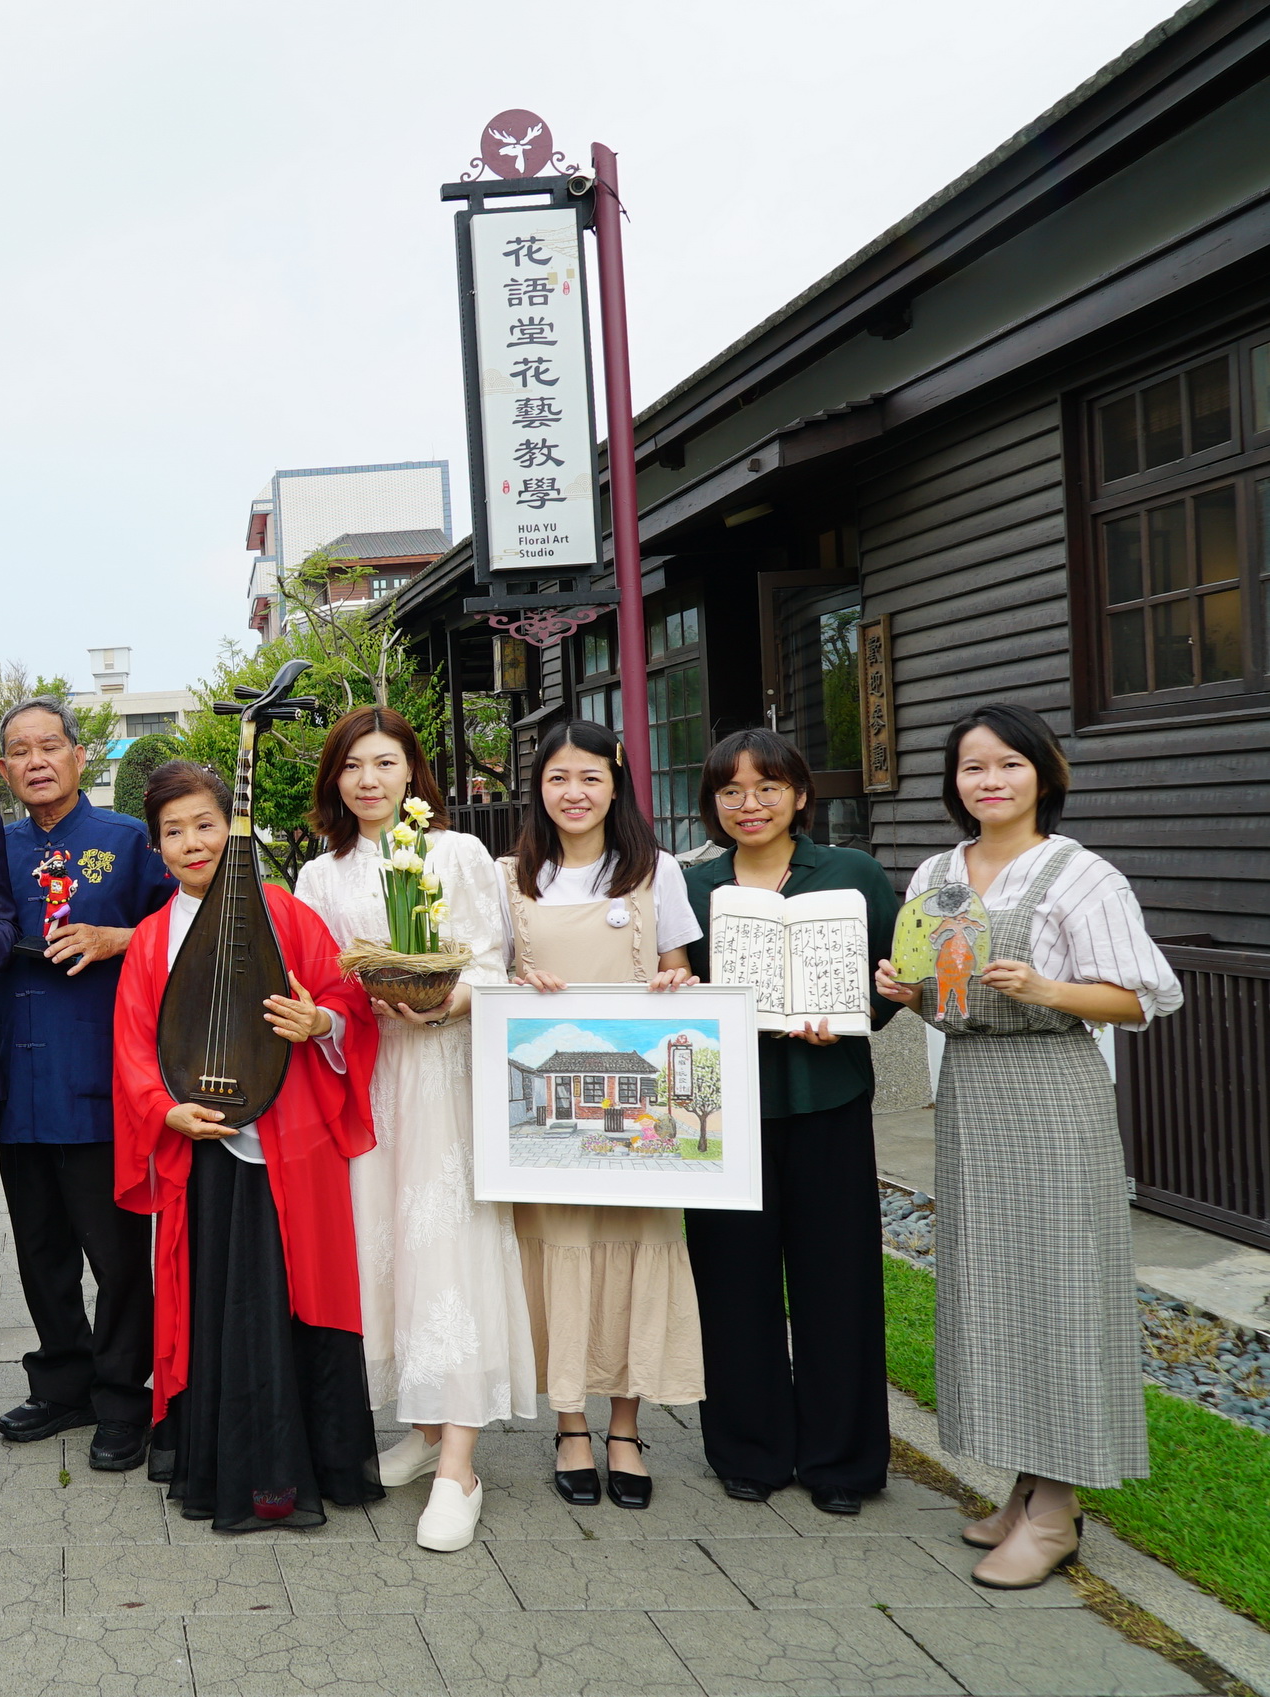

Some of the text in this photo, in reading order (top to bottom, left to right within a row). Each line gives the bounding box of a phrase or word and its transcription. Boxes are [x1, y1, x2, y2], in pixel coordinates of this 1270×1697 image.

[502, 235, 568, 510] 花語堂花藝教學
[518, 523, 557, 533] HUA YU
[519, 535, 569, 546] Floral Art
[519, 547, 555, 558] Studio
[867, 635, 889, 772] 歡迎參觀
